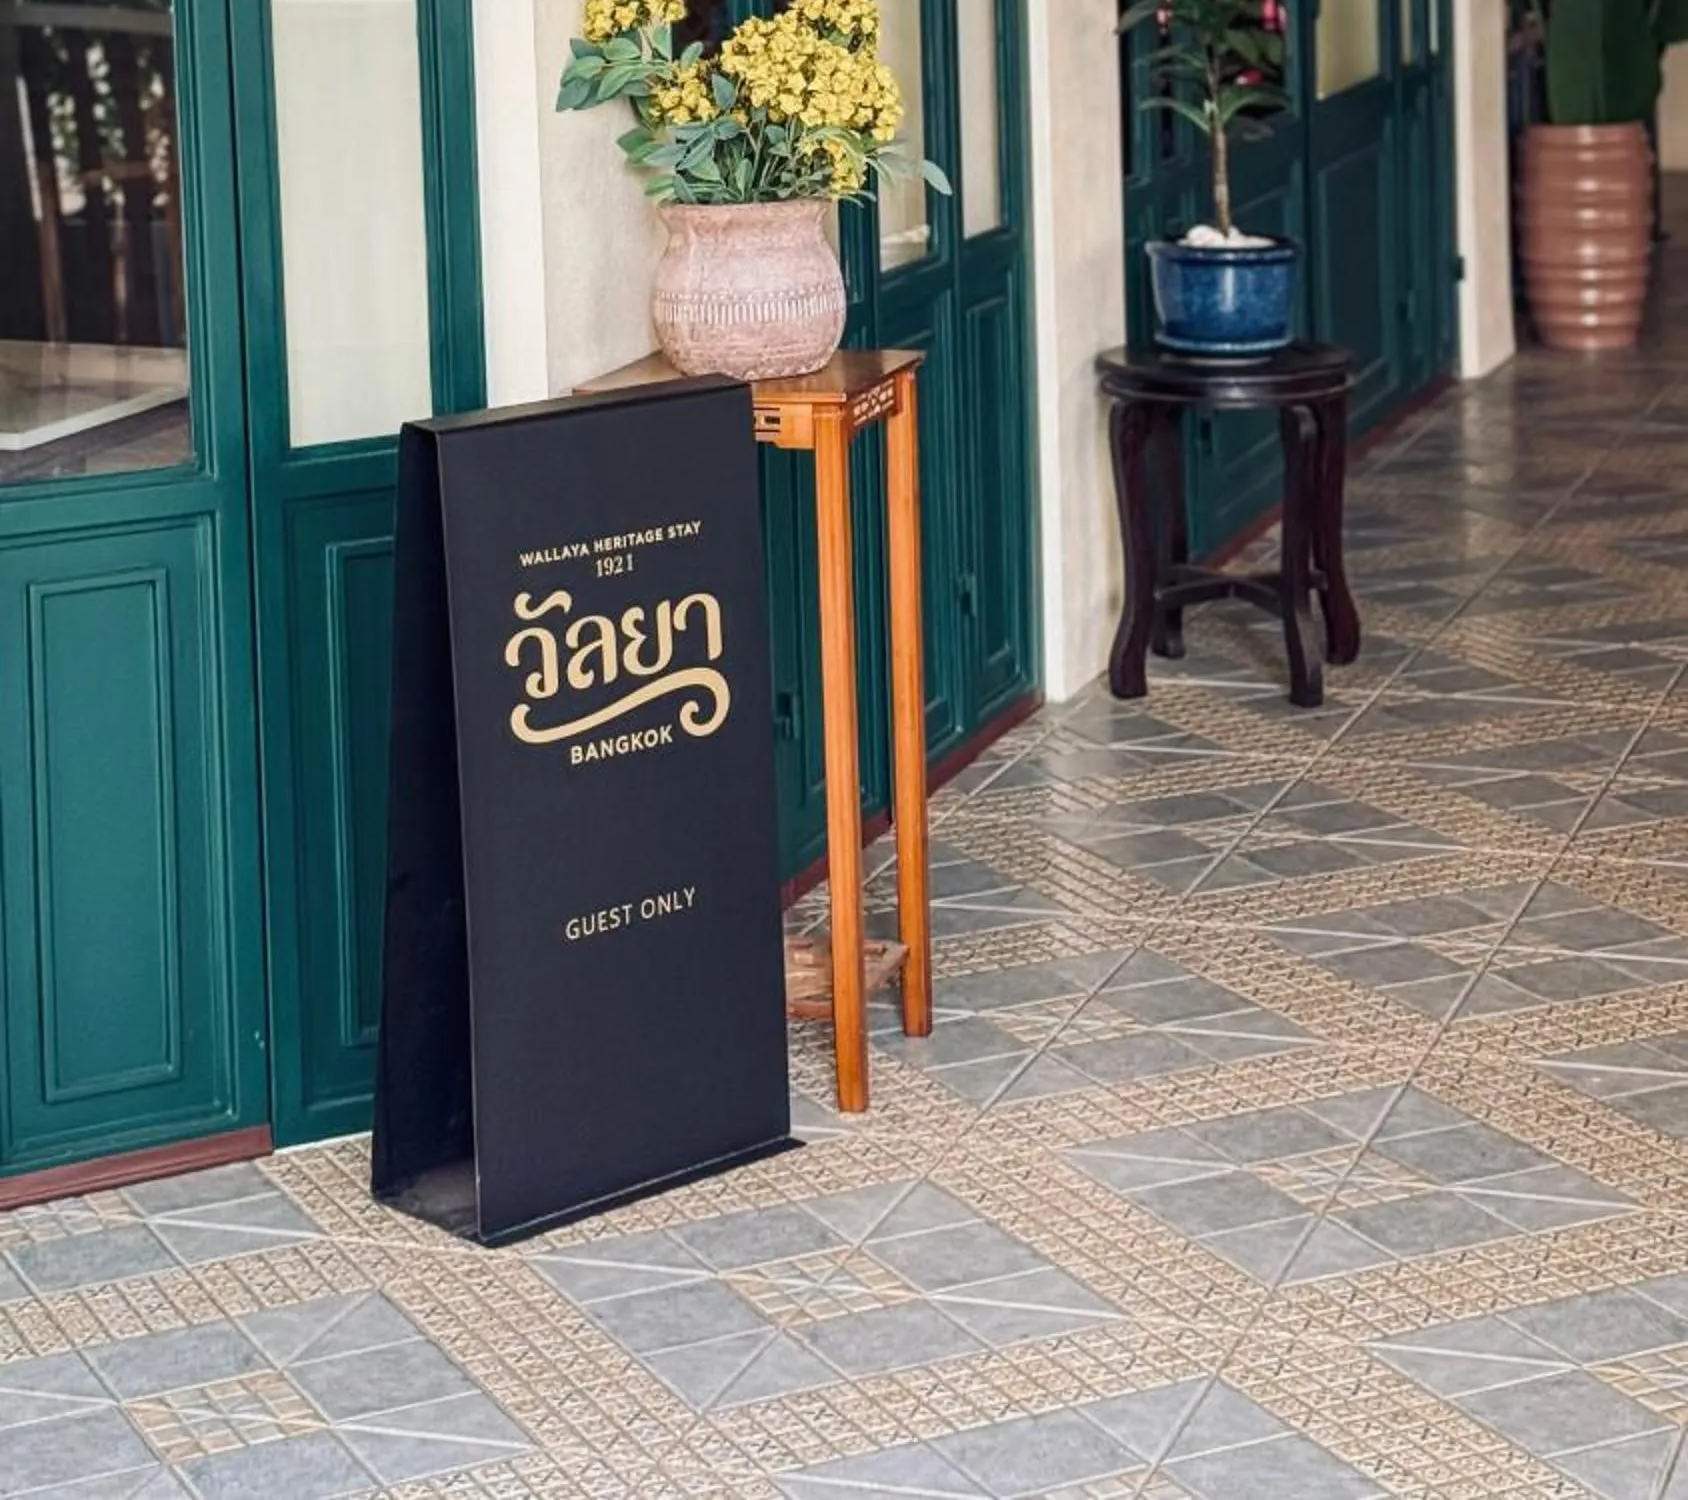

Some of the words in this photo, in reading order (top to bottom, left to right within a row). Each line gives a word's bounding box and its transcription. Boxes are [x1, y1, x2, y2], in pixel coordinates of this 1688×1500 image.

[519, 543, 590, 568] WALLAYA
[593, 527, 664, 553] HERITAGE
[667, 520, 702, 539] STAY
[595, 553, 634, 578] 1921
[504, 589, 723, 699] วัลยา
[570, 723, 674, 766] BANGKOK
[565, 903, 634, 941] GUEST
[640, 886, 697, 920] ONLY
